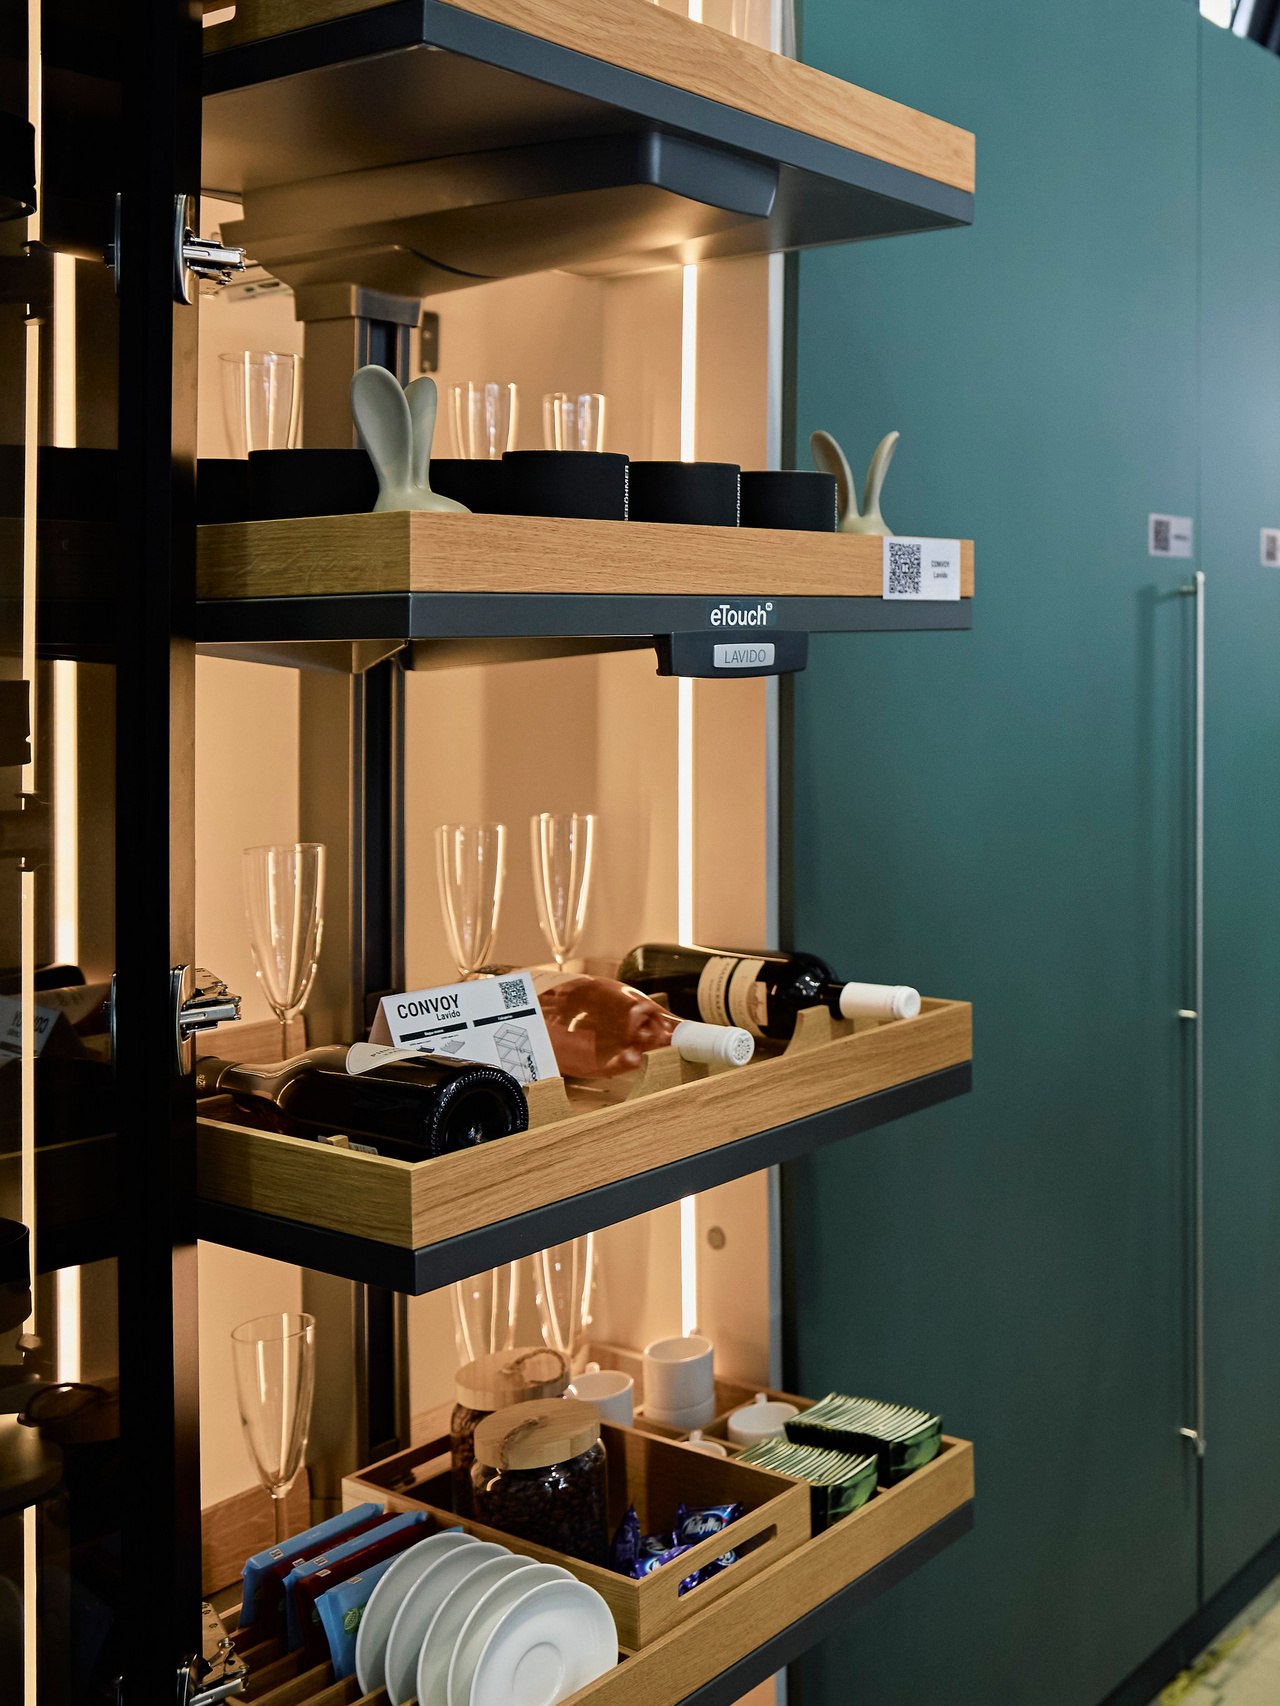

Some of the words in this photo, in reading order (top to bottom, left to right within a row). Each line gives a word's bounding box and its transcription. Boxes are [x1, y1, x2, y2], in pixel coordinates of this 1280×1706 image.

[710, 605, 767, 626] eTouch
[724, 649, 767, 664] LAVIDO
[397, 994, 459, 1019] CONVOY
[436, 1011, 461, 1021] Lavido
